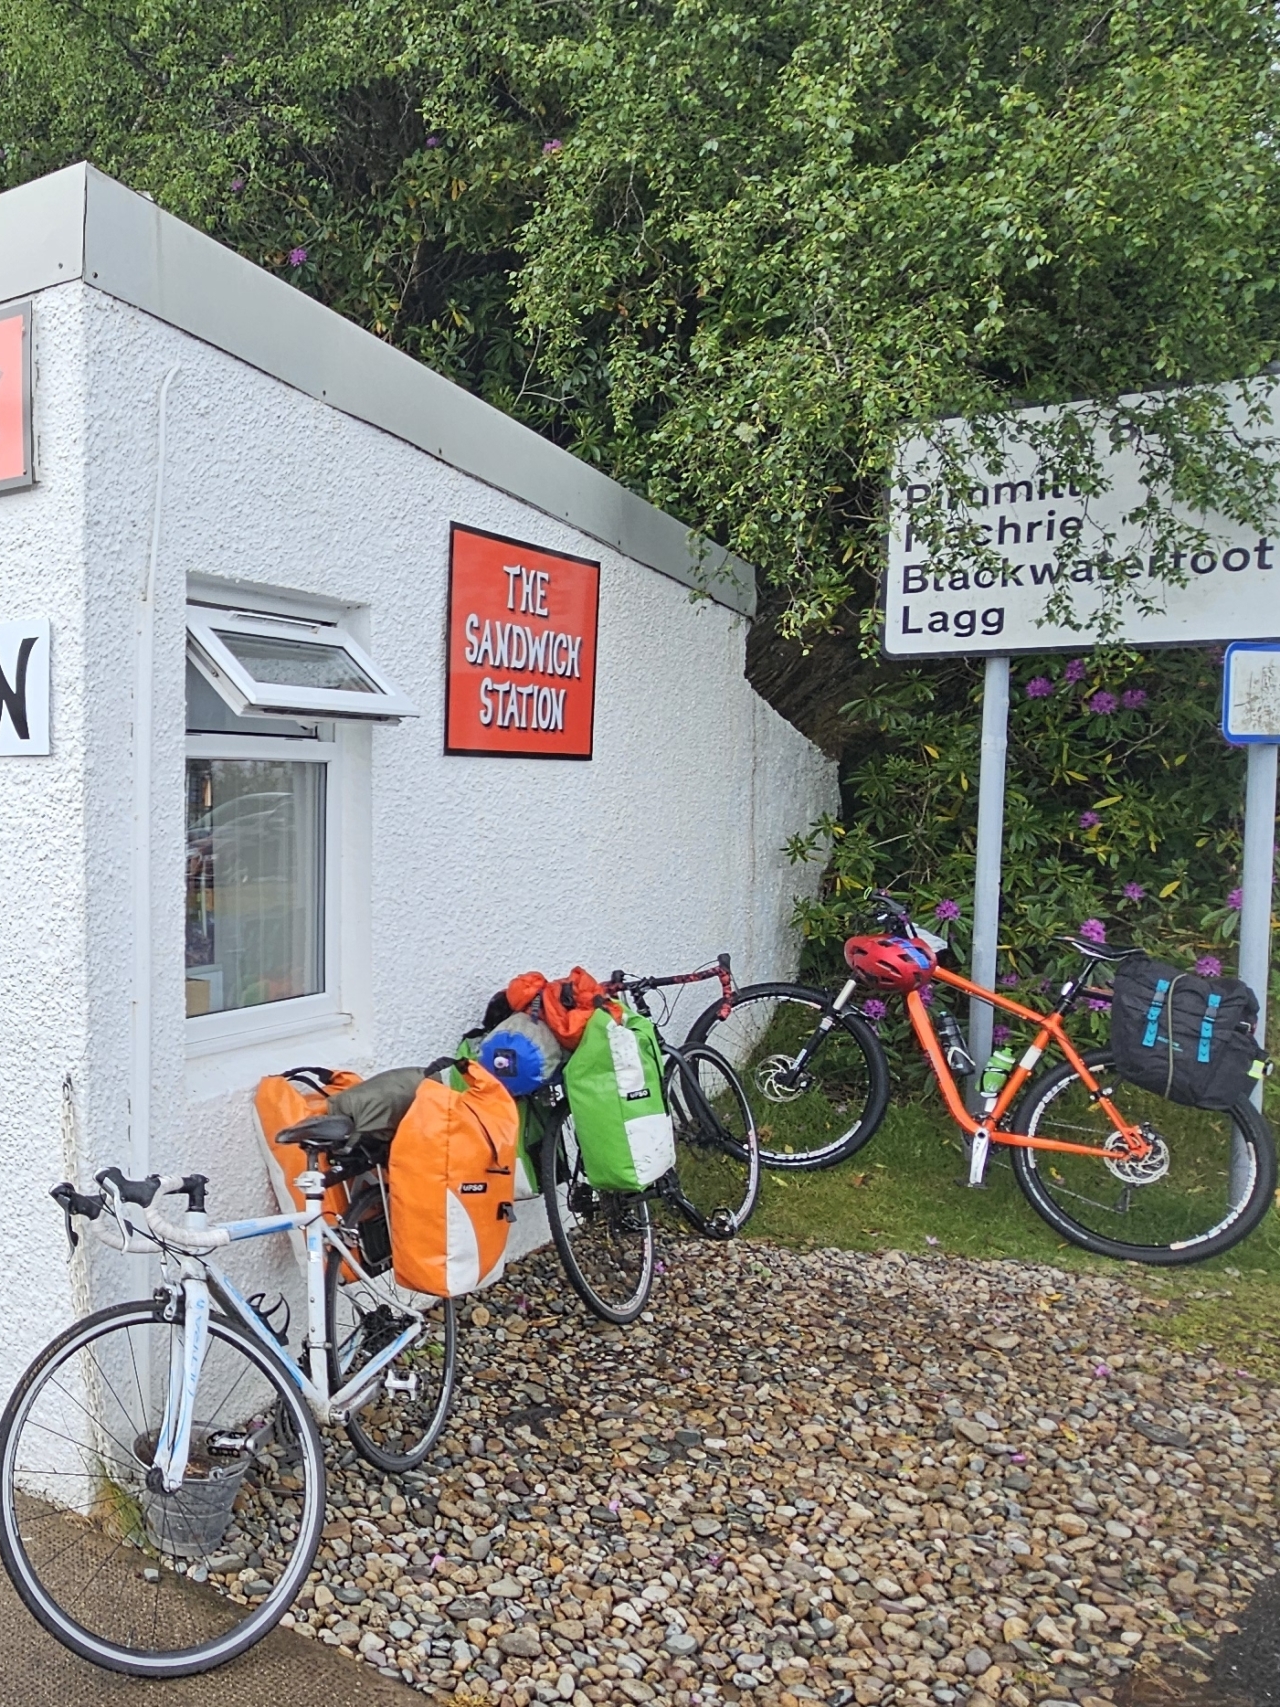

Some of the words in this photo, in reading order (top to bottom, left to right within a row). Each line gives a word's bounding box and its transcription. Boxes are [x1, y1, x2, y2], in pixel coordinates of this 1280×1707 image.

[905, 510, 1083, 552] chrie
[503, 565, 549, 617] THE
[465, 613, 581, 678] SANDWICH
[902, 605, 1005, 638] Lagg
[479, 677, 566, 731] STATION
